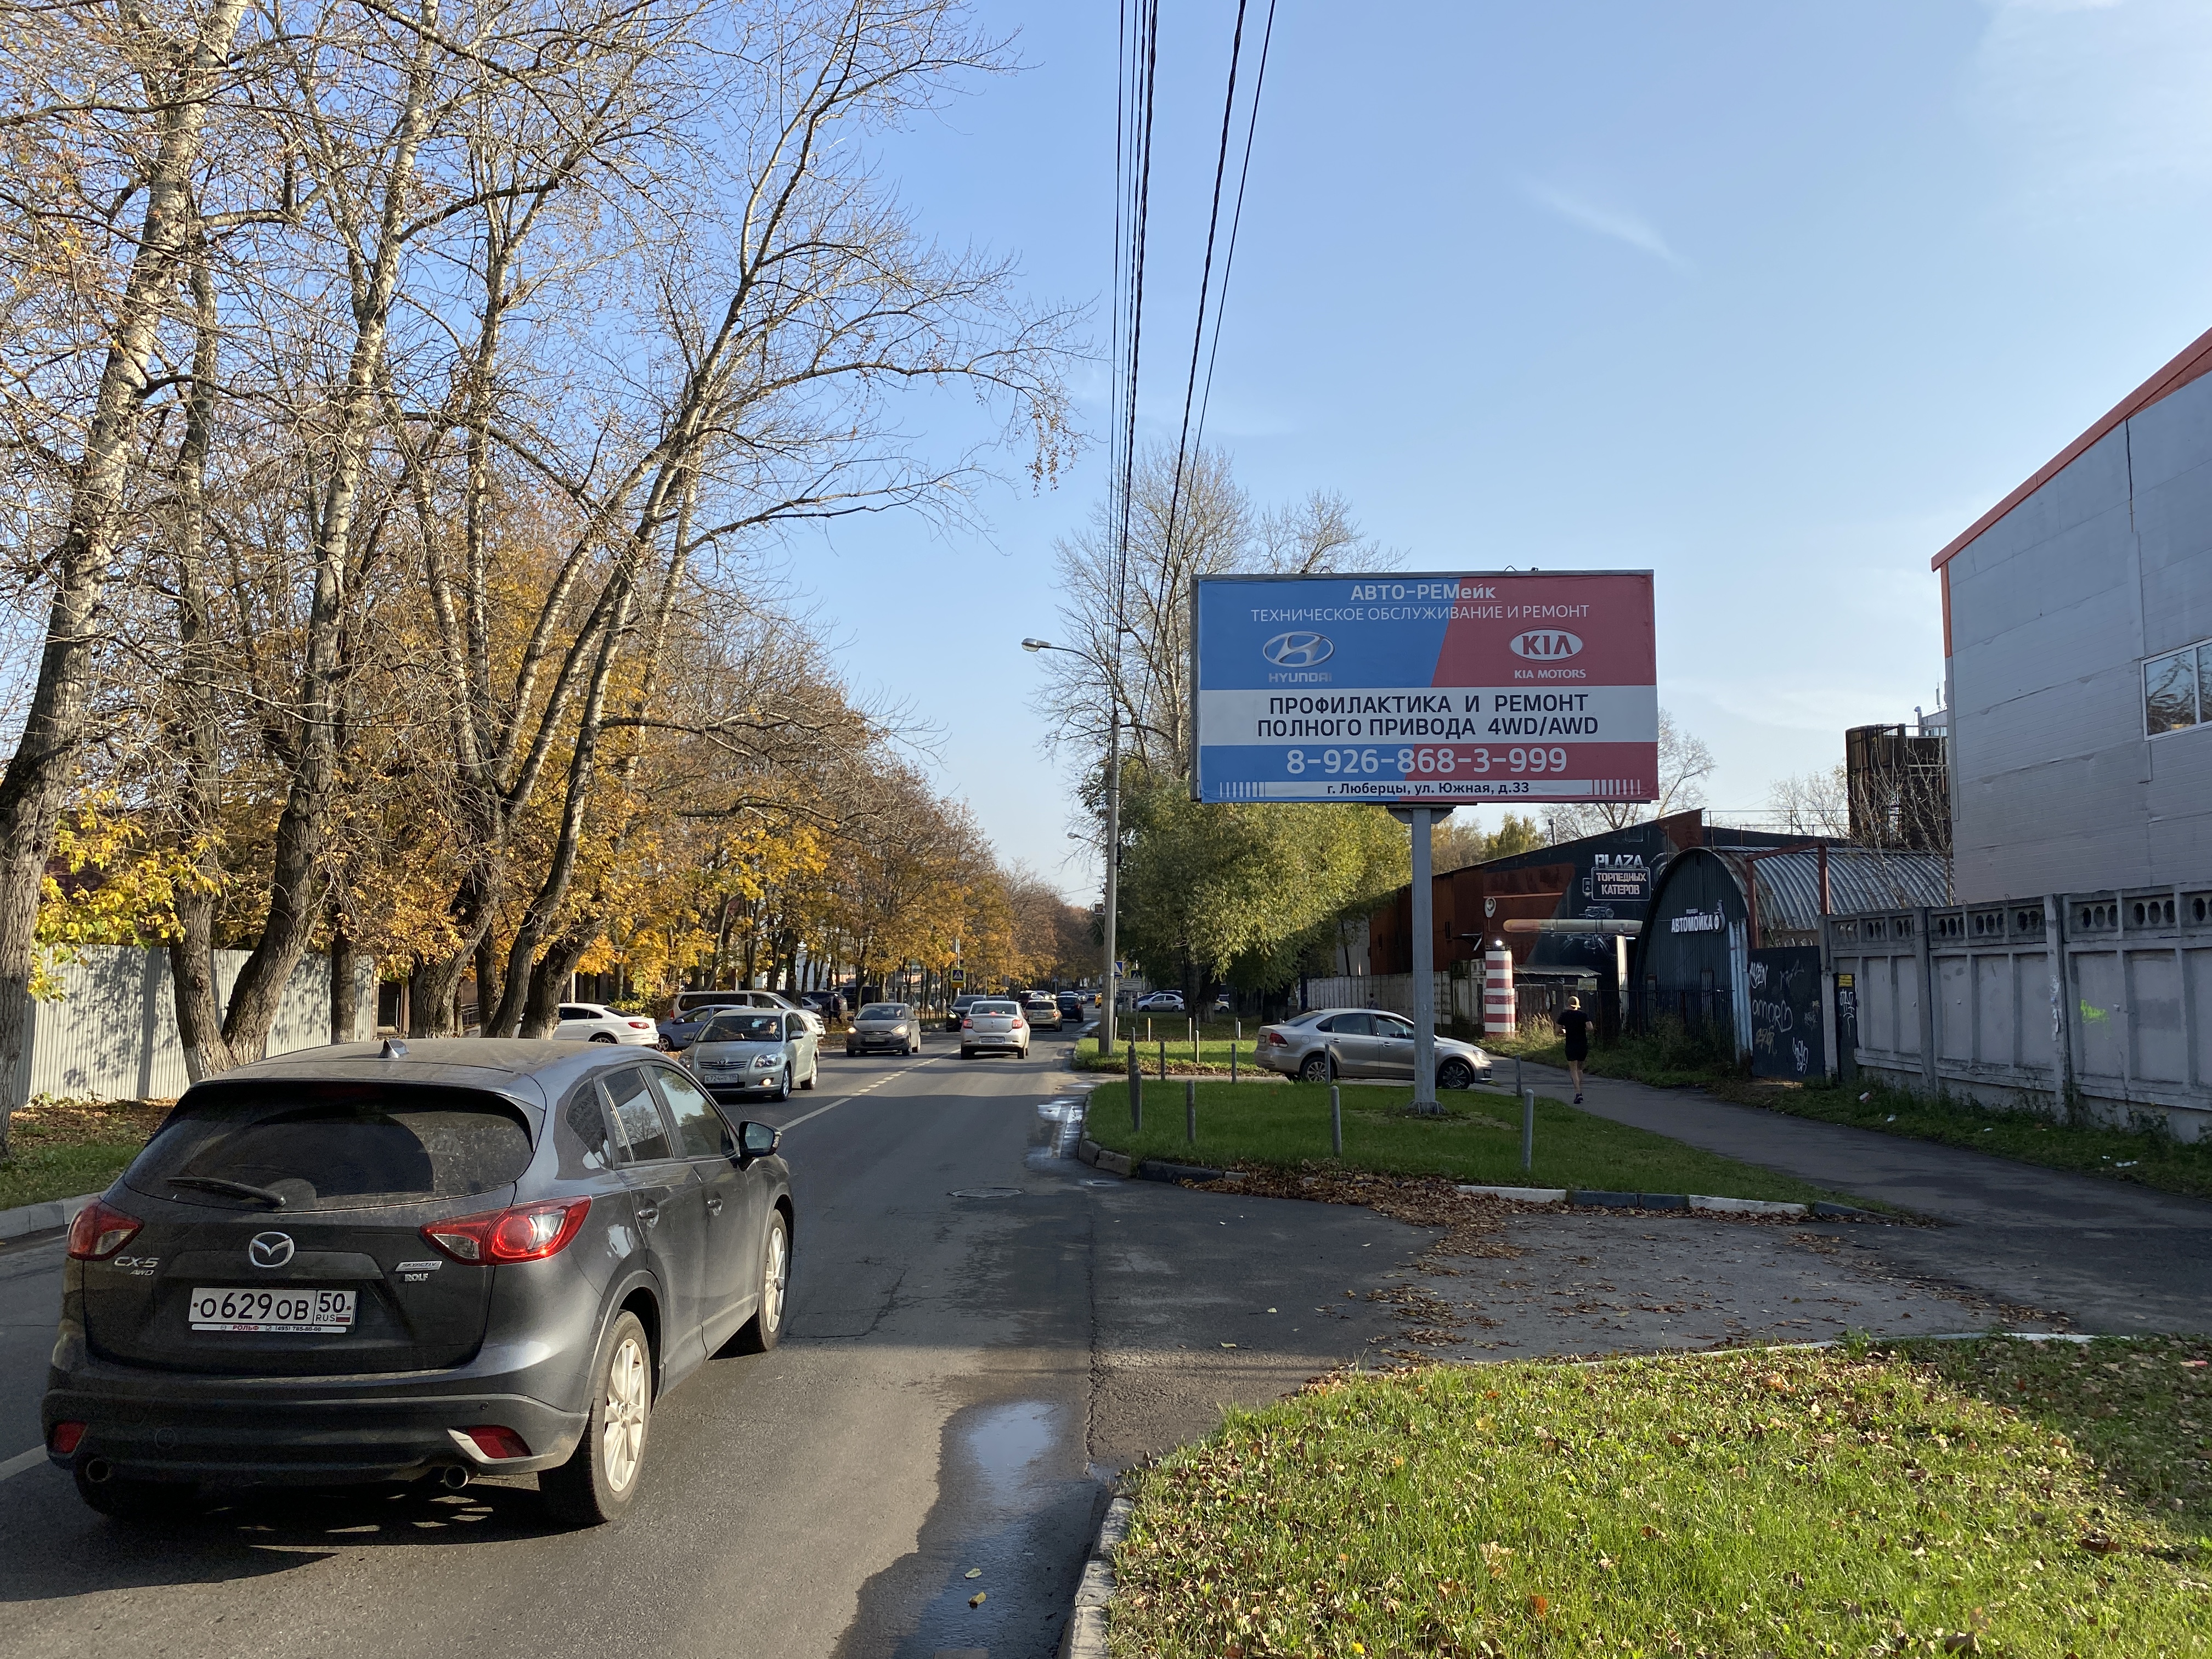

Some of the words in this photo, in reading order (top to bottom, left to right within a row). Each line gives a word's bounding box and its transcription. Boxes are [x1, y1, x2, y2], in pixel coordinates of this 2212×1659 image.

[1351, 584, 1496, 600] АВТО-РЕМейк
[1251, 608, 1364, 622] ТЕХНИЧЕСКОЕ
[1368, 606, 1503, 620] ОБСЛУЖИВАНИЕ
[1508, 606, 1519, 618] И
[1523, 605, 1590, 618] РЕМОНТ
[1522, 635, 1573, 654] KIA
[1268, 672, 1333, 683] HYUNDAI
[1514, 669, 1534, 679] KIA
[1537, 669, 1587, 679] MOTORS
[1269, 695, 1452, 714] ПРОФИЛАКТИКА
[1465, 695, 1480, 713] И
[1495, 694, 1589, 712] РЕМОНТ
[1258, 719, 1362, 737] ПОЛНОГО
[1370, 718, 1476, 740] ПРИВОДА
[1487, 716, 1598, 736] 4WD/AWD
[1286, 747, 1567, 774] 8-926-868-3-999
[1327, 785, 1336, 794] г.
[1340, 782, 1410, 795] Люберцы,
[1415, 785, 1435, 795] ул.
[1439, 782, 1494, 795] Южная,
[1498, 782, 1530, 794] д.33
[1595, 854, 1644, 868] PLAZA
[1596, 872, 1646, 882] ТОРПЕДНЫХ
[1601, 884, 1640, 895] КАТЕРОВ
[1671, 912, 1713, 933] АВТОМОЙКА
[114, 1256, 160, 1268] CX-5
[404, 1273, 428, 1282] ROLF
[200, 1293, 309, 1321] О629ОВ
[318, 1293, 346, 1313] 50
[315, 1314, 335, 1322] RUS
